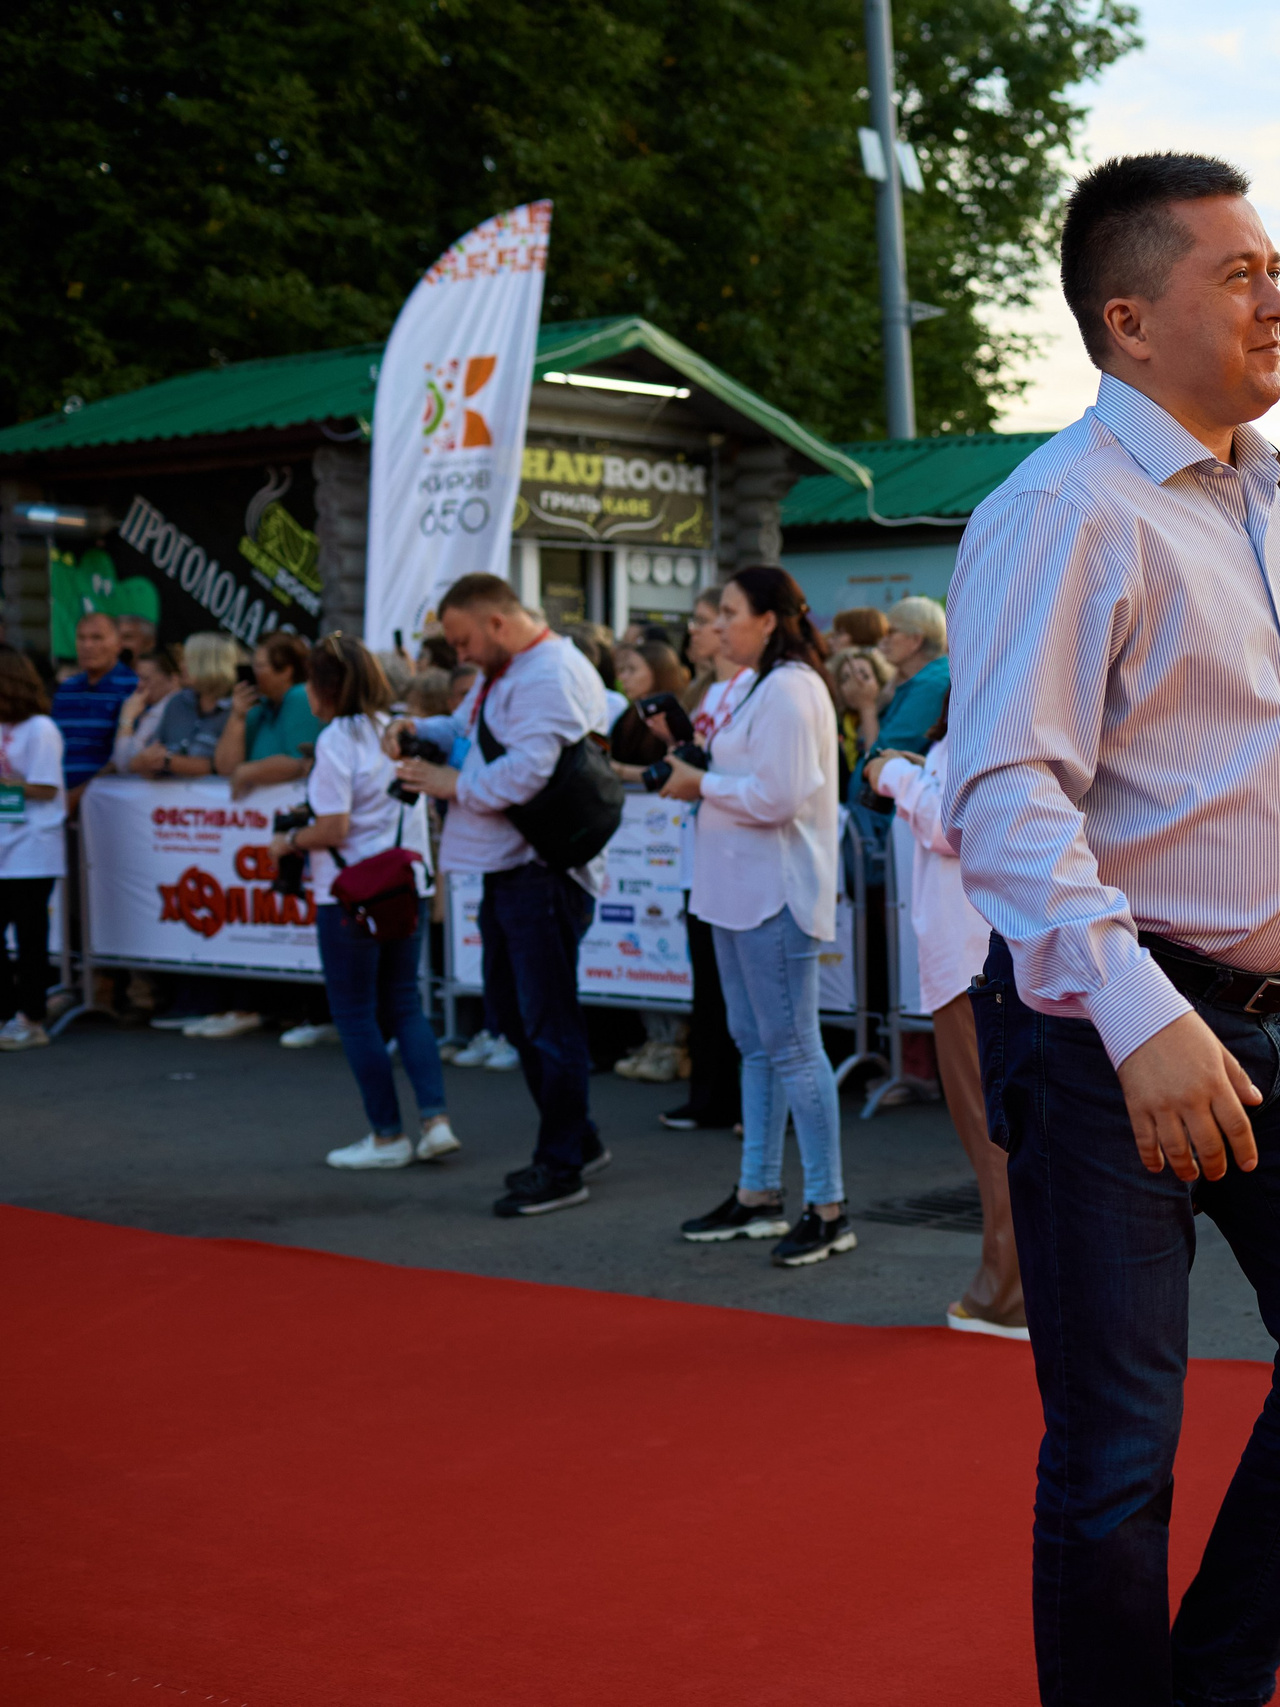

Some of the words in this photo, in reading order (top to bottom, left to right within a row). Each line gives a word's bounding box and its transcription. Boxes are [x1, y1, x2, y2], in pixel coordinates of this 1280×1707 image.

[521, 447, 707, 495] HAUROOM
[419, 497, 491, 538] 650
[151, 806, 269, 829] ФЕСТИВАЛЬ
